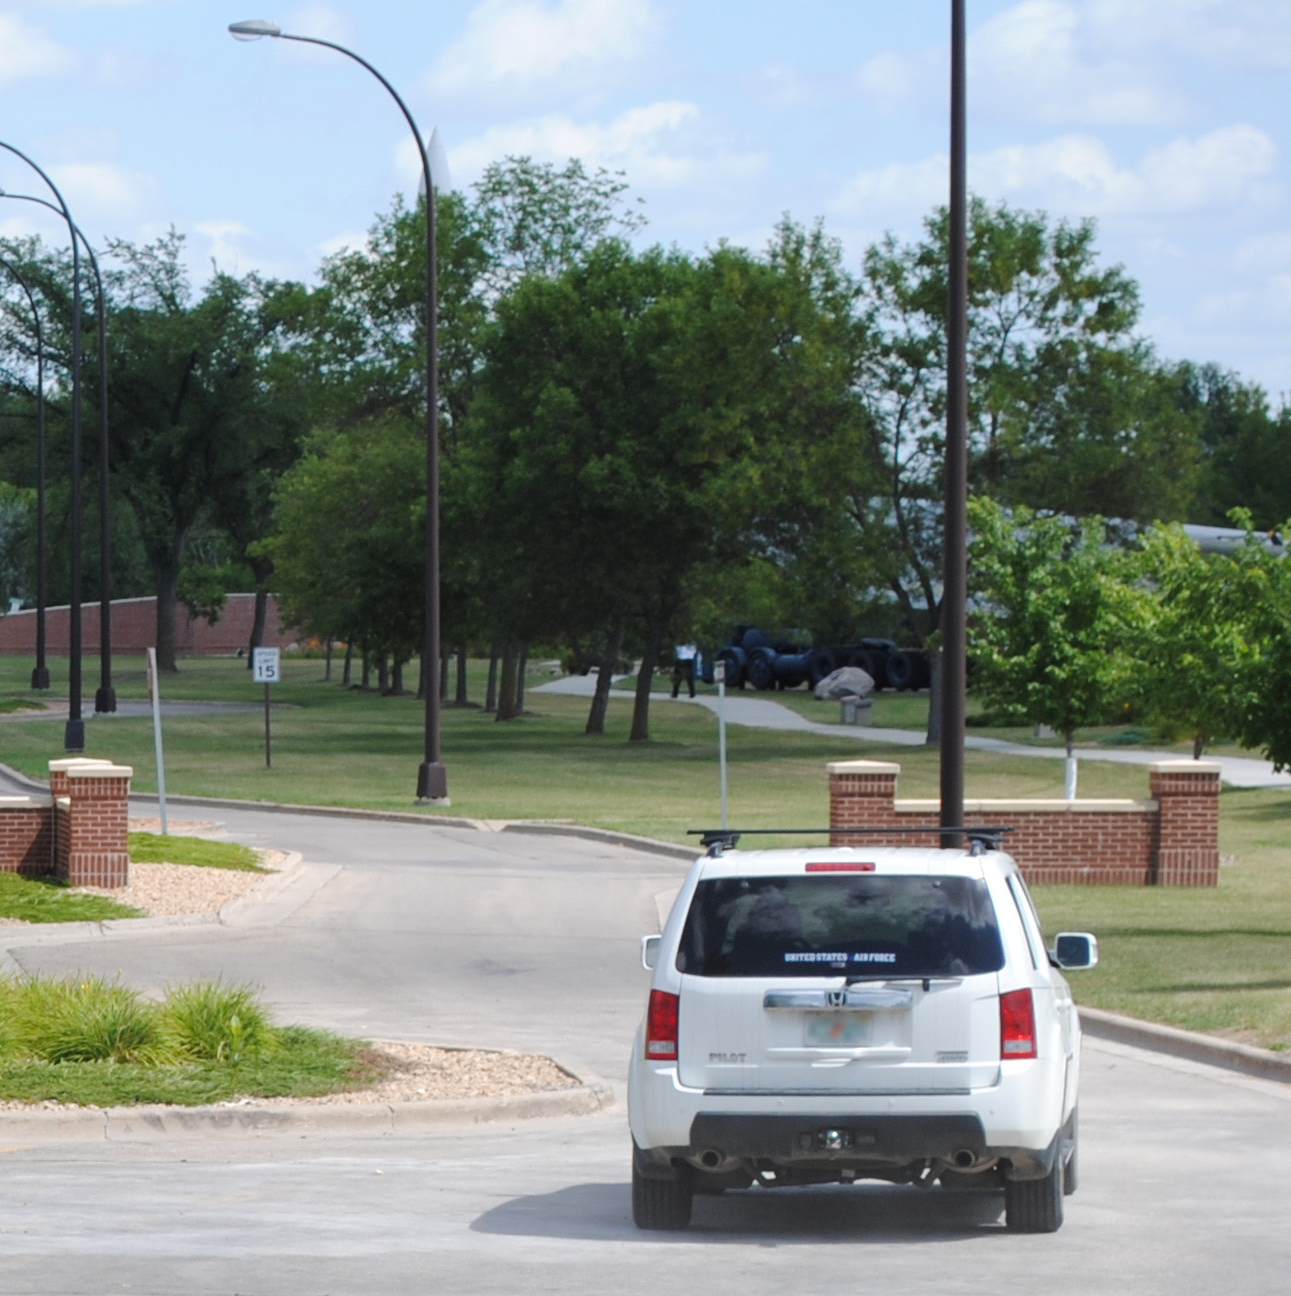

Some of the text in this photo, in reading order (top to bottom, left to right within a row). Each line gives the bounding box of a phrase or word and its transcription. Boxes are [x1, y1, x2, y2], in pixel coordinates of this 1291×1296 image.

[258, 665, 275, 678] 15
[784, 952, 896, 962] UNITED STATES AIR FORCE
[709, 1053, 747, 1063] PILOT
